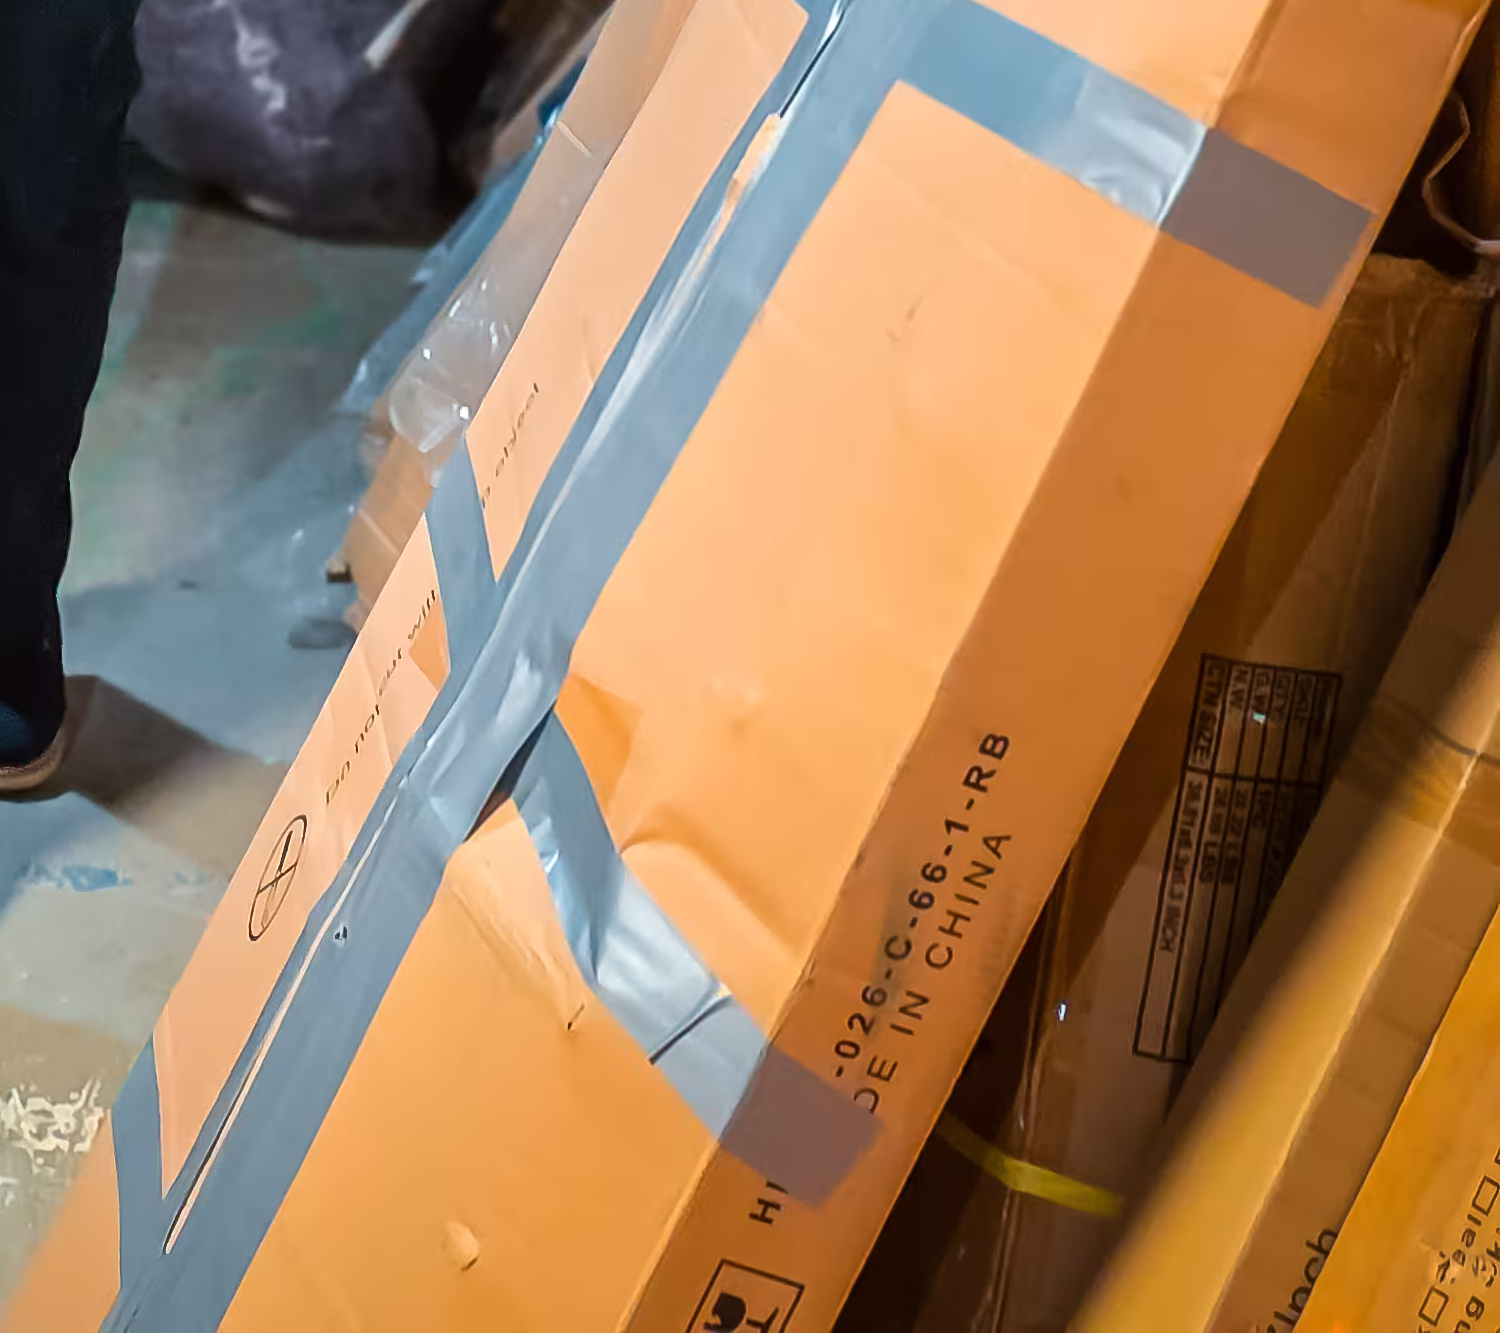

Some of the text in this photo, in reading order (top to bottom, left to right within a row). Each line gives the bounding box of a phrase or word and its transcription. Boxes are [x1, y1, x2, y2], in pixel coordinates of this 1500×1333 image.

[407, 589, 437, 641] wit
[495, 382, 539, 478] object
[853, 1055, 898, 1114] DE
[889, 990, 930, 1036] IN
[925, 835, 1012, 970] CHINA
